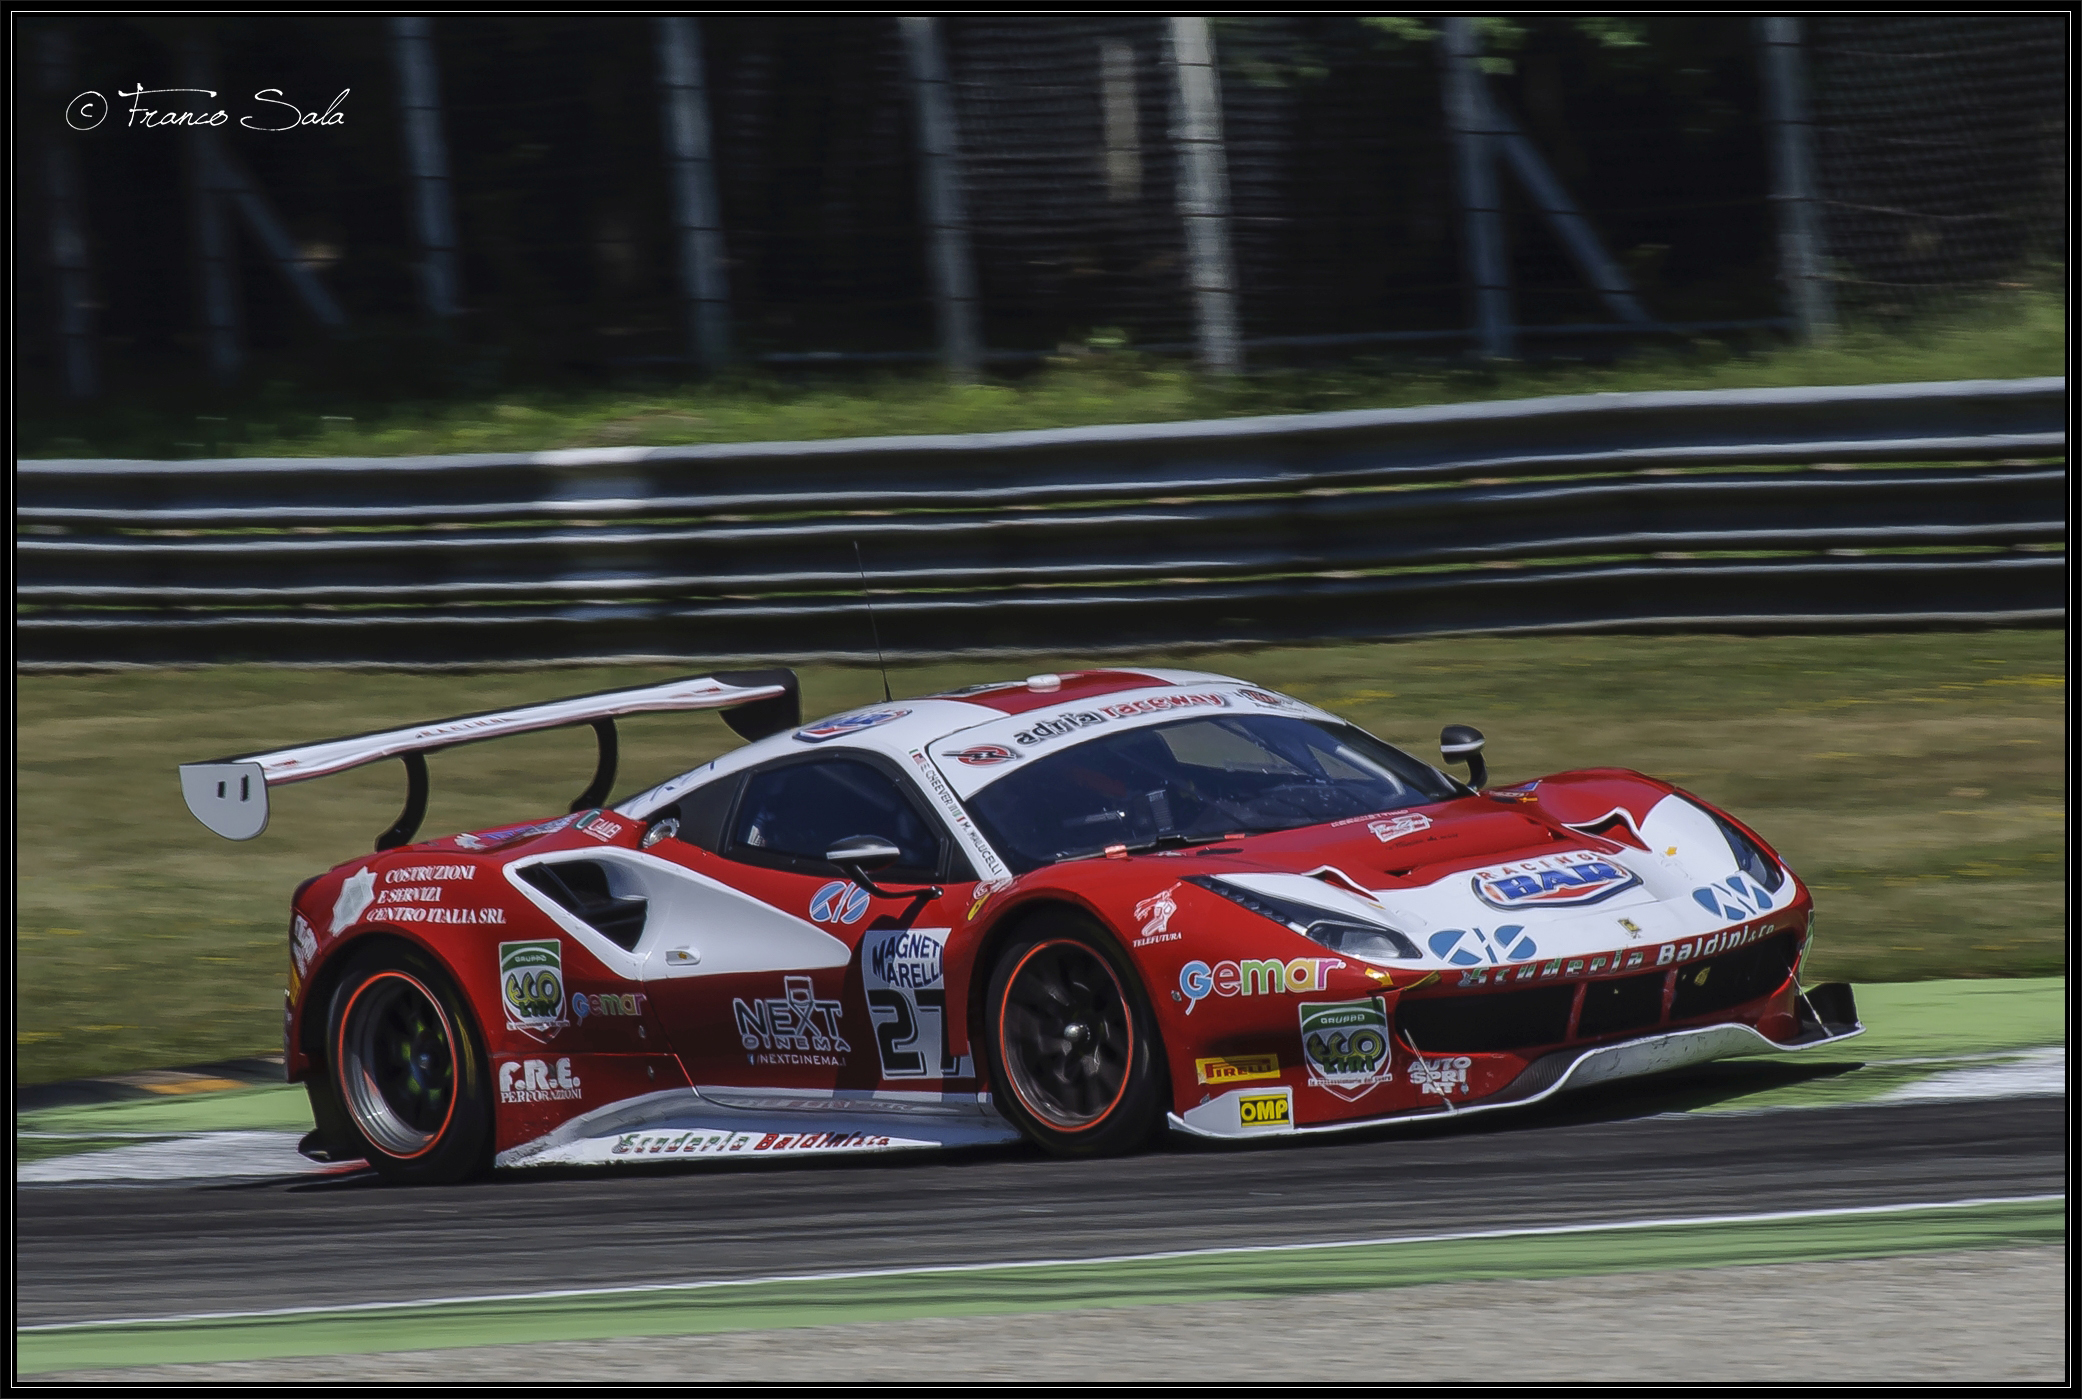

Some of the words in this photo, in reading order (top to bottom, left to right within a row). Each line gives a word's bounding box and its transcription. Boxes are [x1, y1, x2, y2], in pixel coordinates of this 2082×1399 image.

[1013, 709, 1102, 747] adria
[1100, 691, 1226, 718] raceway
[926, 770, 952, 806] CHEEVER
[969, 832, 1003, 876] MALUCELLI
[385, 865, 477, 884] COSTRUZIONI
[1475, 852, 1595, 881] RACING
[1488, 861, 1627, 900] BAR
[389, 886, 443, 902] SERVIZI
[366, 907, 427, 923] CENTRO
[426, 908, 478, 924] ITALIA
[478, 908, 507, 924] SRL
[1132, 931, 1182, 948] TELEFUTURA
[1458, 948, 1645, 988] Scuderia
[1320, 1013, 1365, 1024] GRUPPO
[1407, 1056, 1472, 1073] AUTO
[501, 1088, 583, 1103] PERFORAZIONI
[1241, 1099, 1288, 1122] OMP
[613, 1131, 750, 1154] Scuderia
